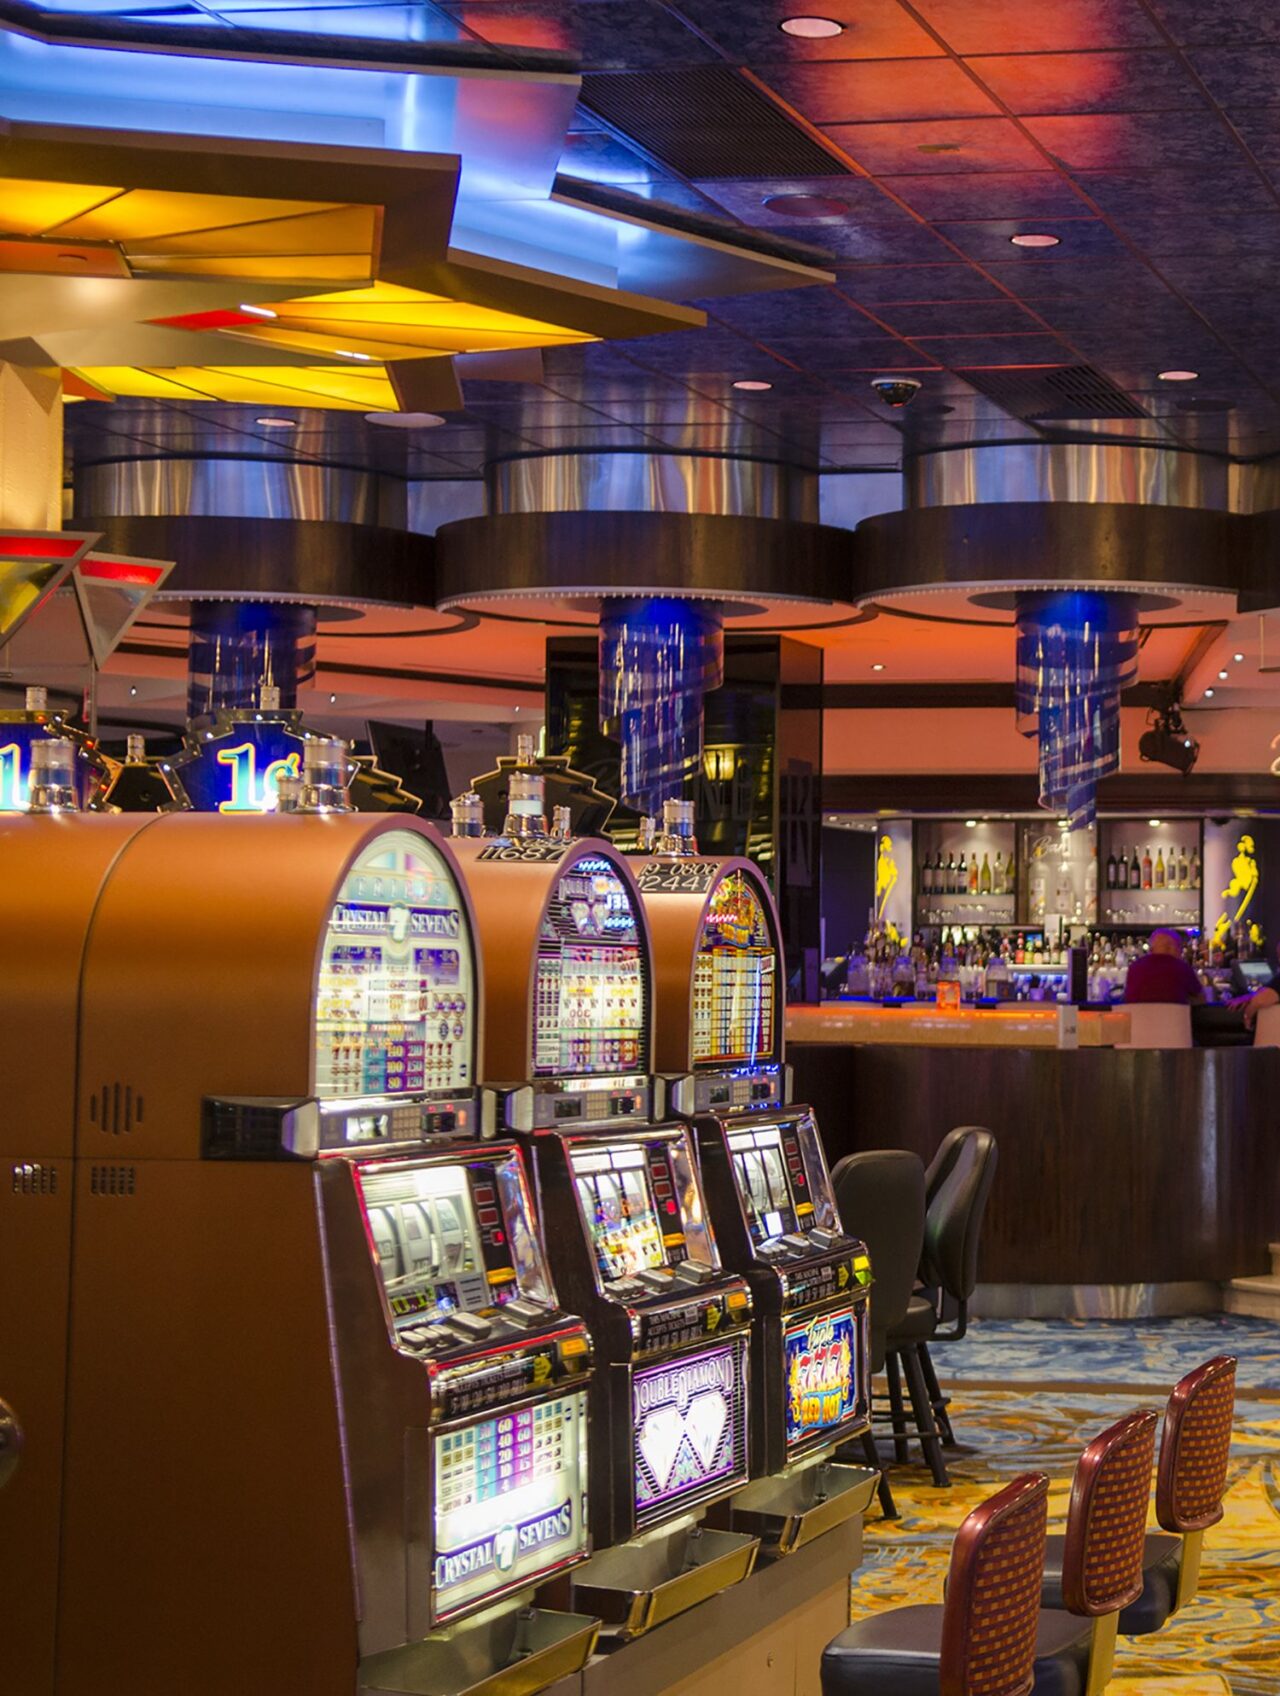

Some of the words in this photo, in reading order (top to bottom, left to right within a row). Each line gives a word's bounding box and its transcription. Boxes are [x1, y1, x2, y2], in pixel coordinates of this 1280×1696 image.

[641, 863, 717, 876] 19-0806
[355, 876, 442, 901] TRIE
[638, 876, 712, 890] 12441
[332, 904, 387, 931] CRYSTAL
[411, 911, 459, 937] SEVENS
[498, 1419, 513, 1434] 60
[517, 1412, 531, 1427] 90
[498, 1434, 513, 1448] 40
[517, 1428, 531, 1442] 60
[498, 1450, 513, 1465] 20
[435, 1542, 494, 1588] CRYSTAL
[519, 1504, 571, 1550] SEVENS
